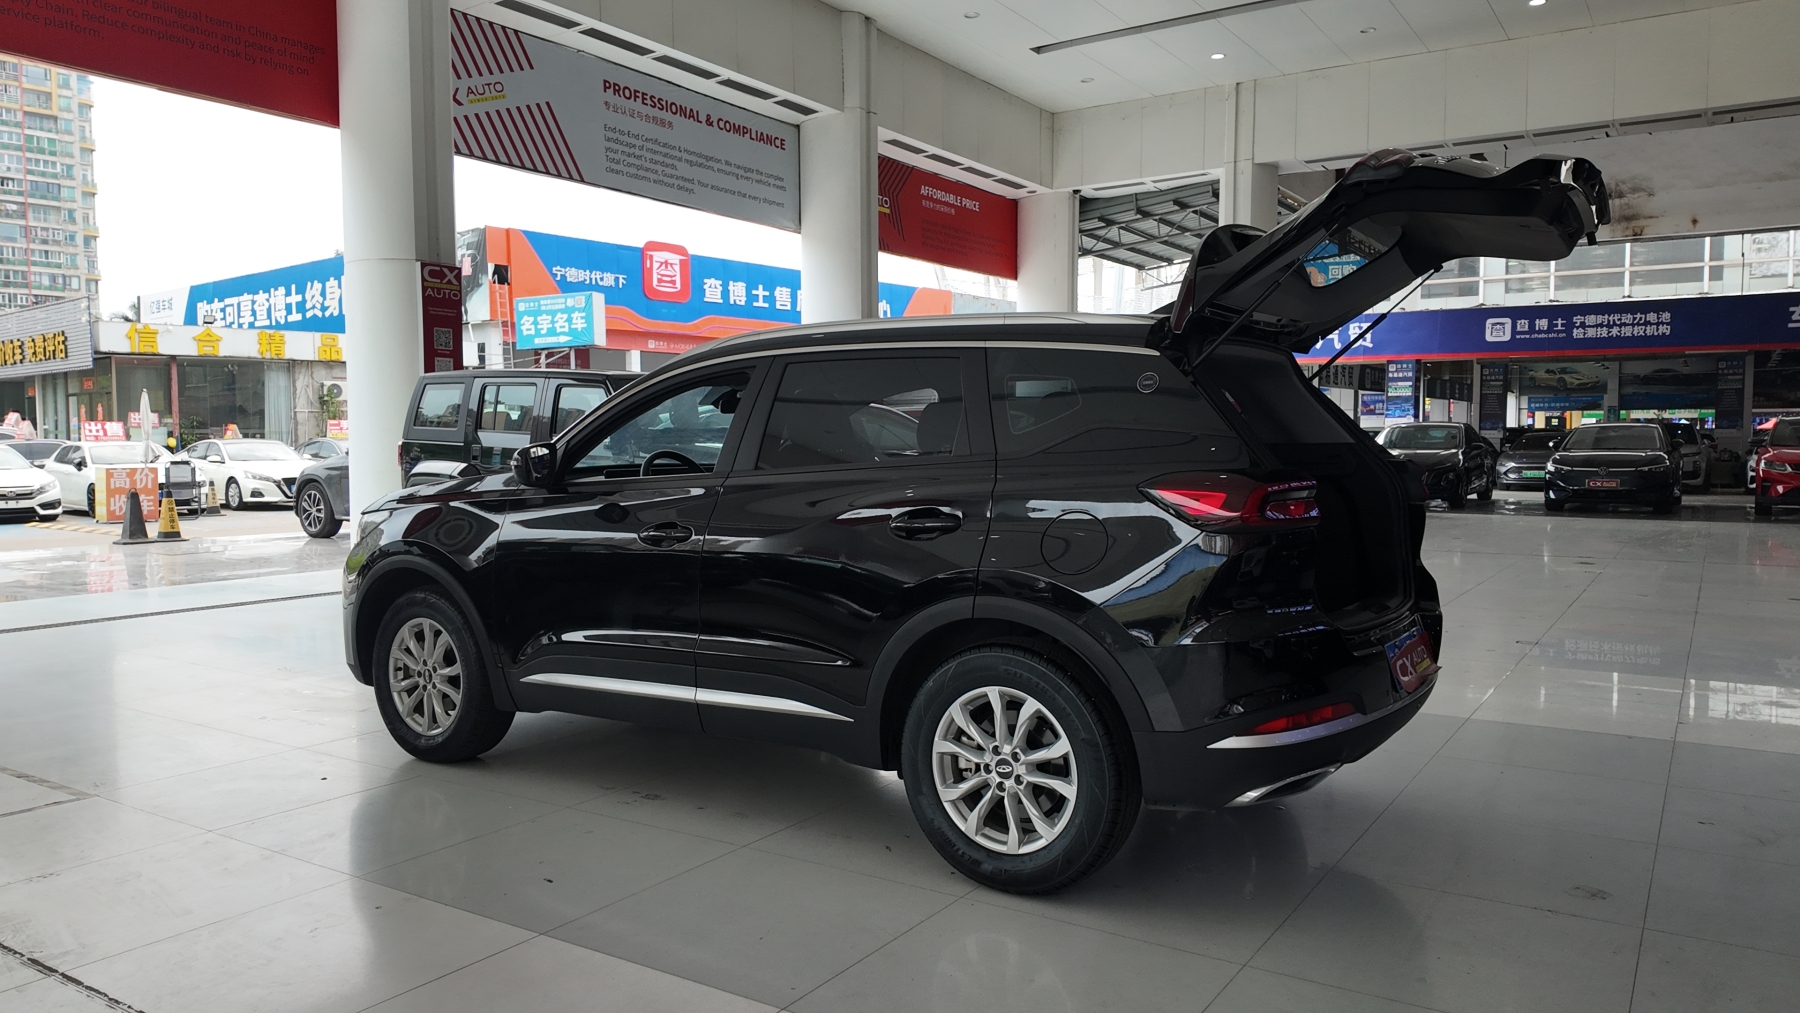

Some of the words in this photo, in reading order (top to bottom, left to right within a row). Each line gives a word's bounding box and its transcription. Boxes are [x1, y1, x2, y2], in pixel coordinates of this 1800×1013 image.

[35, 0, 78, 18] Chain.
[82, 10, 128, 30] Reduce
[131, 24, 196, 49] complexity
[199, 41, 220, 54] and
[222, 46, 242, 59] risk
[244, 51, 257, 64] by
[260, 57, 294, 75] relying
[297, 66, 309, 76] on
[44, 16, 104, 40] platform.
[92, 0, 122, 14] clear
[126, 8, 218, 39] communication
[221, 33, 241, 46] and
[244, 40, 274, 55] peace
[277, 46, 287, 57] of
[289, 51, 315, 65] mind
[152, 0, 202, 21] bilingual
[205, 14, 233, 30] team
[235, 21, 246, 33] in
[248, 25, 278, 42] China
[281, 37, 326, 55] manages
[466, 81, 504, 98] AUTO
[603, 79, 703, 124] PROFESSIONAL
[705, 113, 715, 128] &
[717, 118, 786, 151] COMPLIANCE
[603, 100, 674, 131] 专业认证与合规服务
[603, 124, 640, 141] End-to-End
[641, 134, 677, 152] Certification
[677, 145, 683, 153] &
[683, 146, 724, 165] Homologation.
[724, 159, 733, 168] We
[733, 162, 755, 176] navigate
[755, 168, 764, 177] the
[764, 171, 785, 183] complex
[604, 145, 620, 158] your
[620, 149, 648, 164] market's
[648, 156, 679, 172] standards.
[604, 133, 637, 151] landscape
[638, 143, 645, 152] of
[645, 145, 683, 163] international
[683, 157, 716, 173] regulations,
[717, 166, 740, 181] ensuring
[740, 173, 754, 184] every
[754, 175, 772, 188] vehicle
[772, 181, 787, 192] meets
[604, 154, 621, 166] Total
[622, 159, 661, 177] Compliance,
[661, 169, 697, 186] Guaranteed.
[697, 178, 710, 190] Your
[710, 183, 737, 196] assurance
[737, 188, 748, 199] that
[748, 193, 762, 204] every
[762, 196, 785, 209] shipment
[605, 166, 625, 177] clears
[625, 171, 651, 183] customs
[652, 177, 675, 189] without
[676, 182, 697, 195] delays.
[920, 185, 961, 206] AFFORDABLE
[961, 199, 980, 212] PRICE
[423, 265, 460, 285] CX
[552, 265, 628, 289] 宁德时代旗下
[196, 279, 345, 328] 购车可享查博士终身
[425, 288, 461, 300] AUTO
[703, 278, 802, 312] 查博士售
[520, 311, 587, 336] 名宇名车
[1516, 317, 1567, 332] 查博士
[1572, 311, 1671, 327] 宁德时代动力电池
[1572, 324, 1671, 339] 检测技术授权机构
[26, 330, 68, 362] 免费评估
[126, 322, 344, 362] 信合精品
[84, 421, 124, 436] 出售
[109, 468, 155, 489] 高价
[110, 494, 155, 516] 收车
[1396, 654, 1416, 682] CX
[1412, 645, 1427, 665] AUTO
